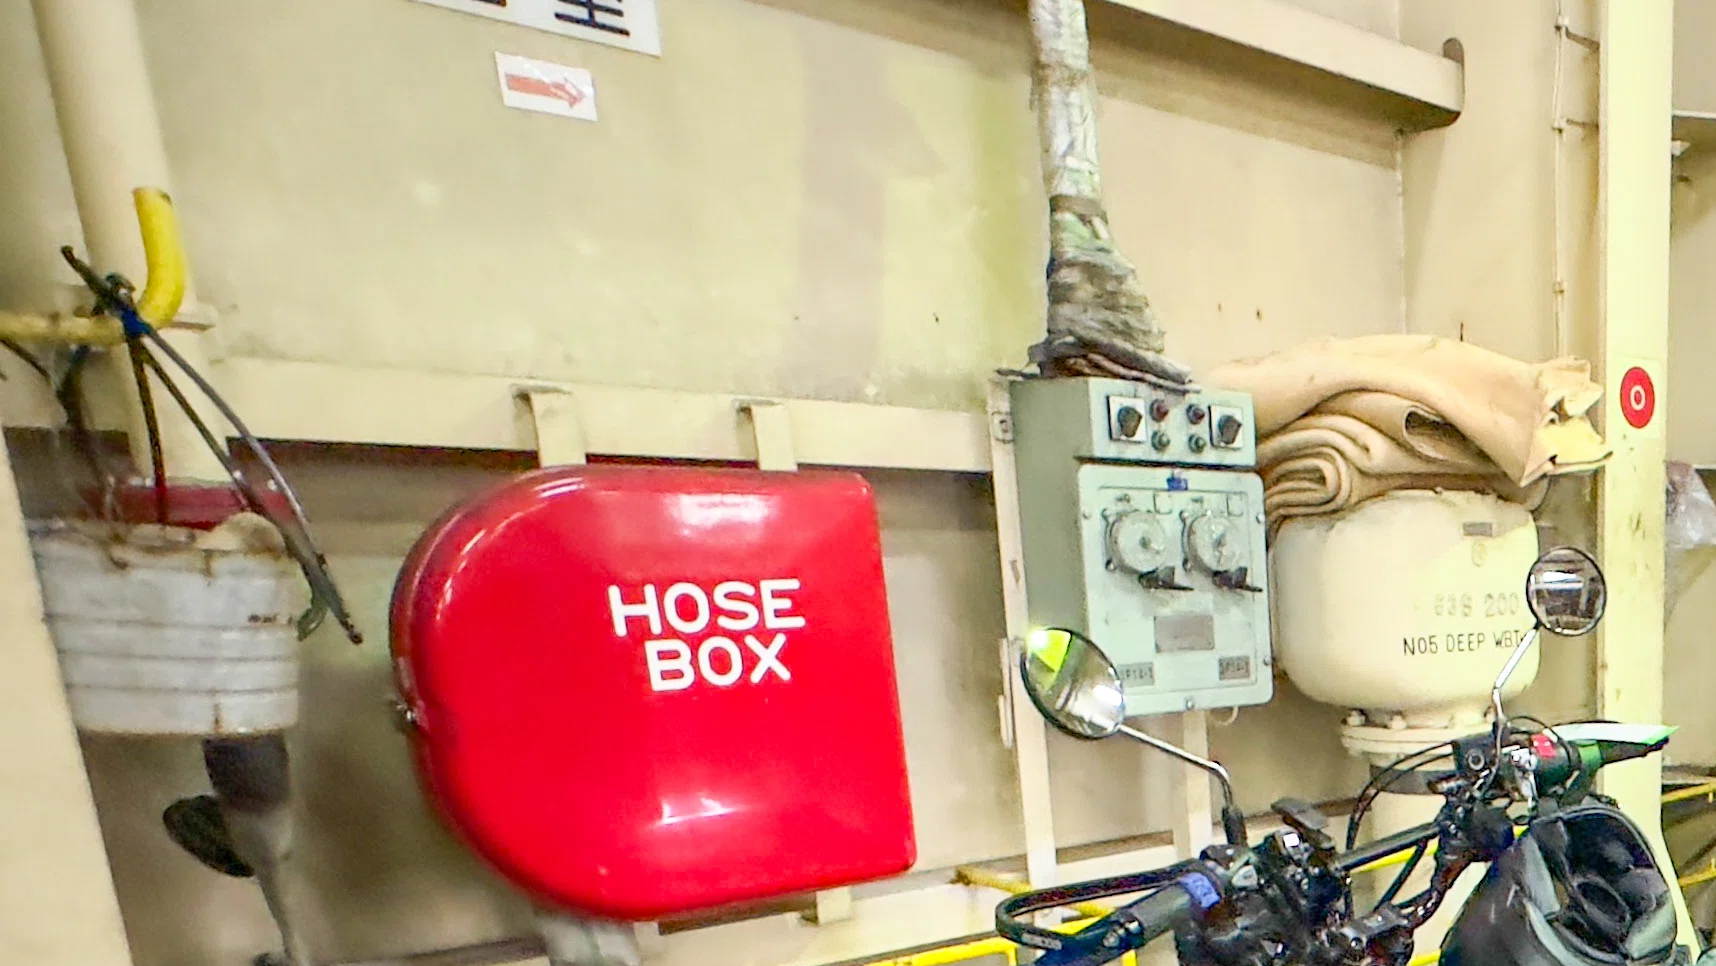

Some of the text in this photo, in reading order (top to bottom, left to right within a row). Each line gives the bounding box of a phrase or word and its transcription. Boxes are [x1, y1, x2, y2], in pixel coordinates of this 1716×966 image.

[607, 578, 806, 637] HOSE
[644, 633, 791, 691] BOX
[1446, 632, 1485, 652] DEEP
